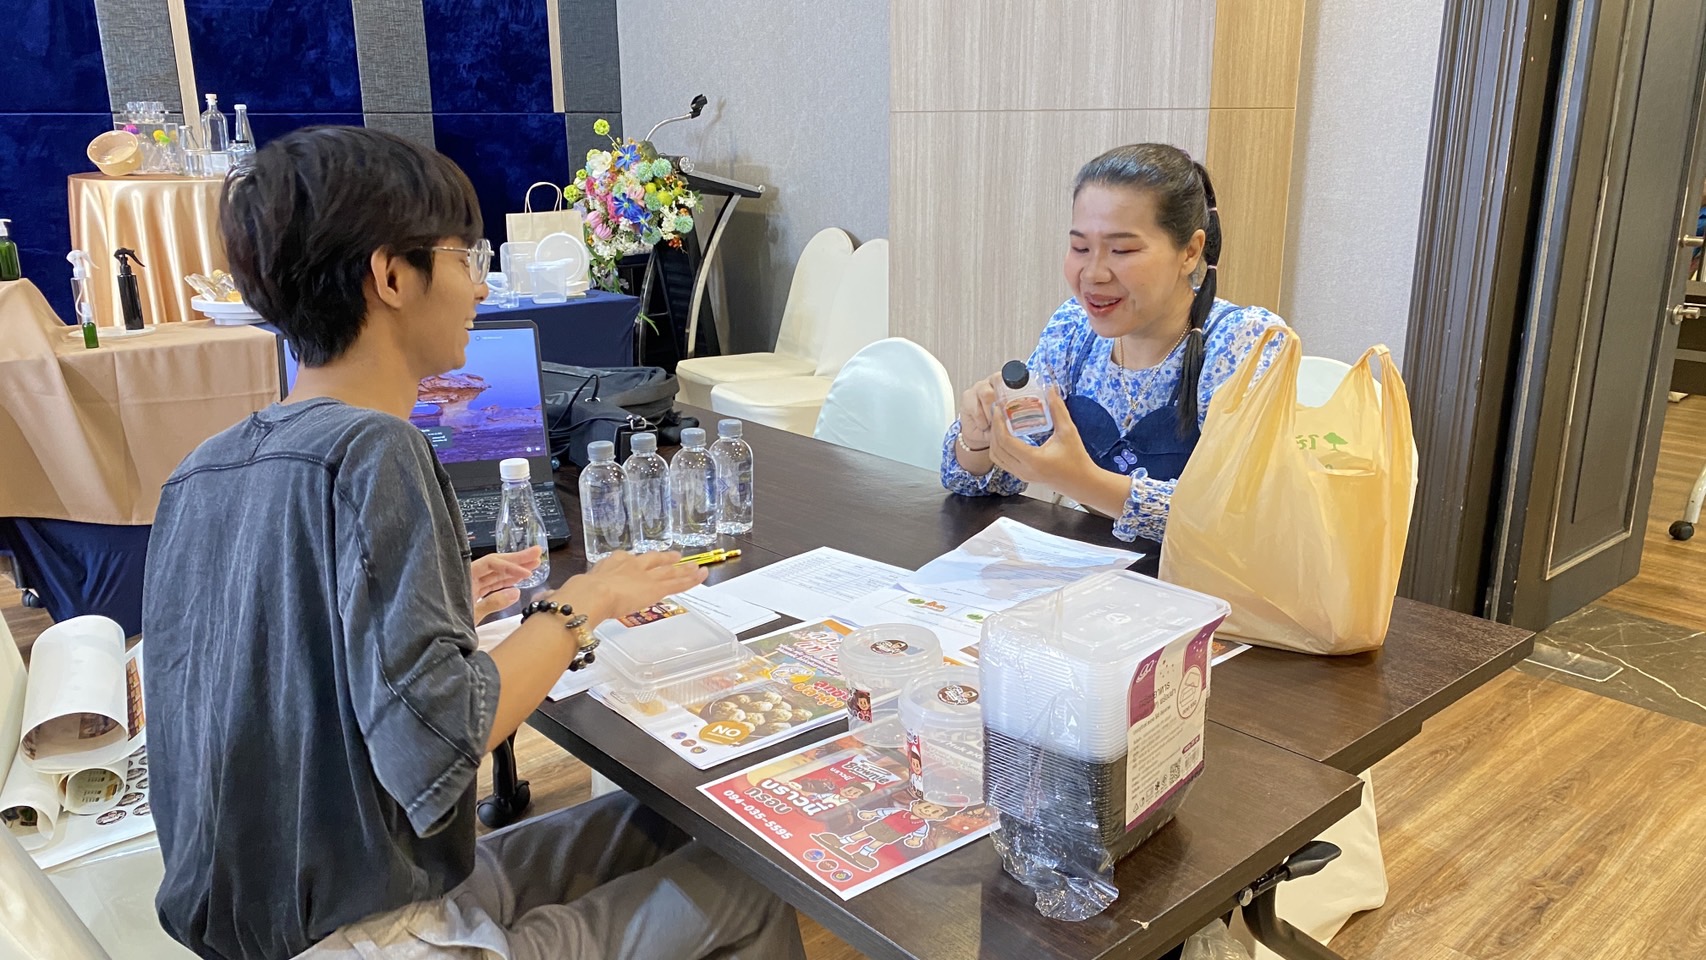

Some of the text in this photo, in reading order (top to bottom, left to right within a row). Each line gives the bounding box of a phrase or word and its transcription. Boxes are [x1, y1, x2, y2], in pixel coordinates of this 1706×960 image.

[712, 724, 741, 737] NO
[843, 761, 890, 784] Brownie
[744, 787, 792, 814] กรอบ
[761, 779, 835, 816] บราวนี่
[723, 789, 793, 840] 094-035-5595
